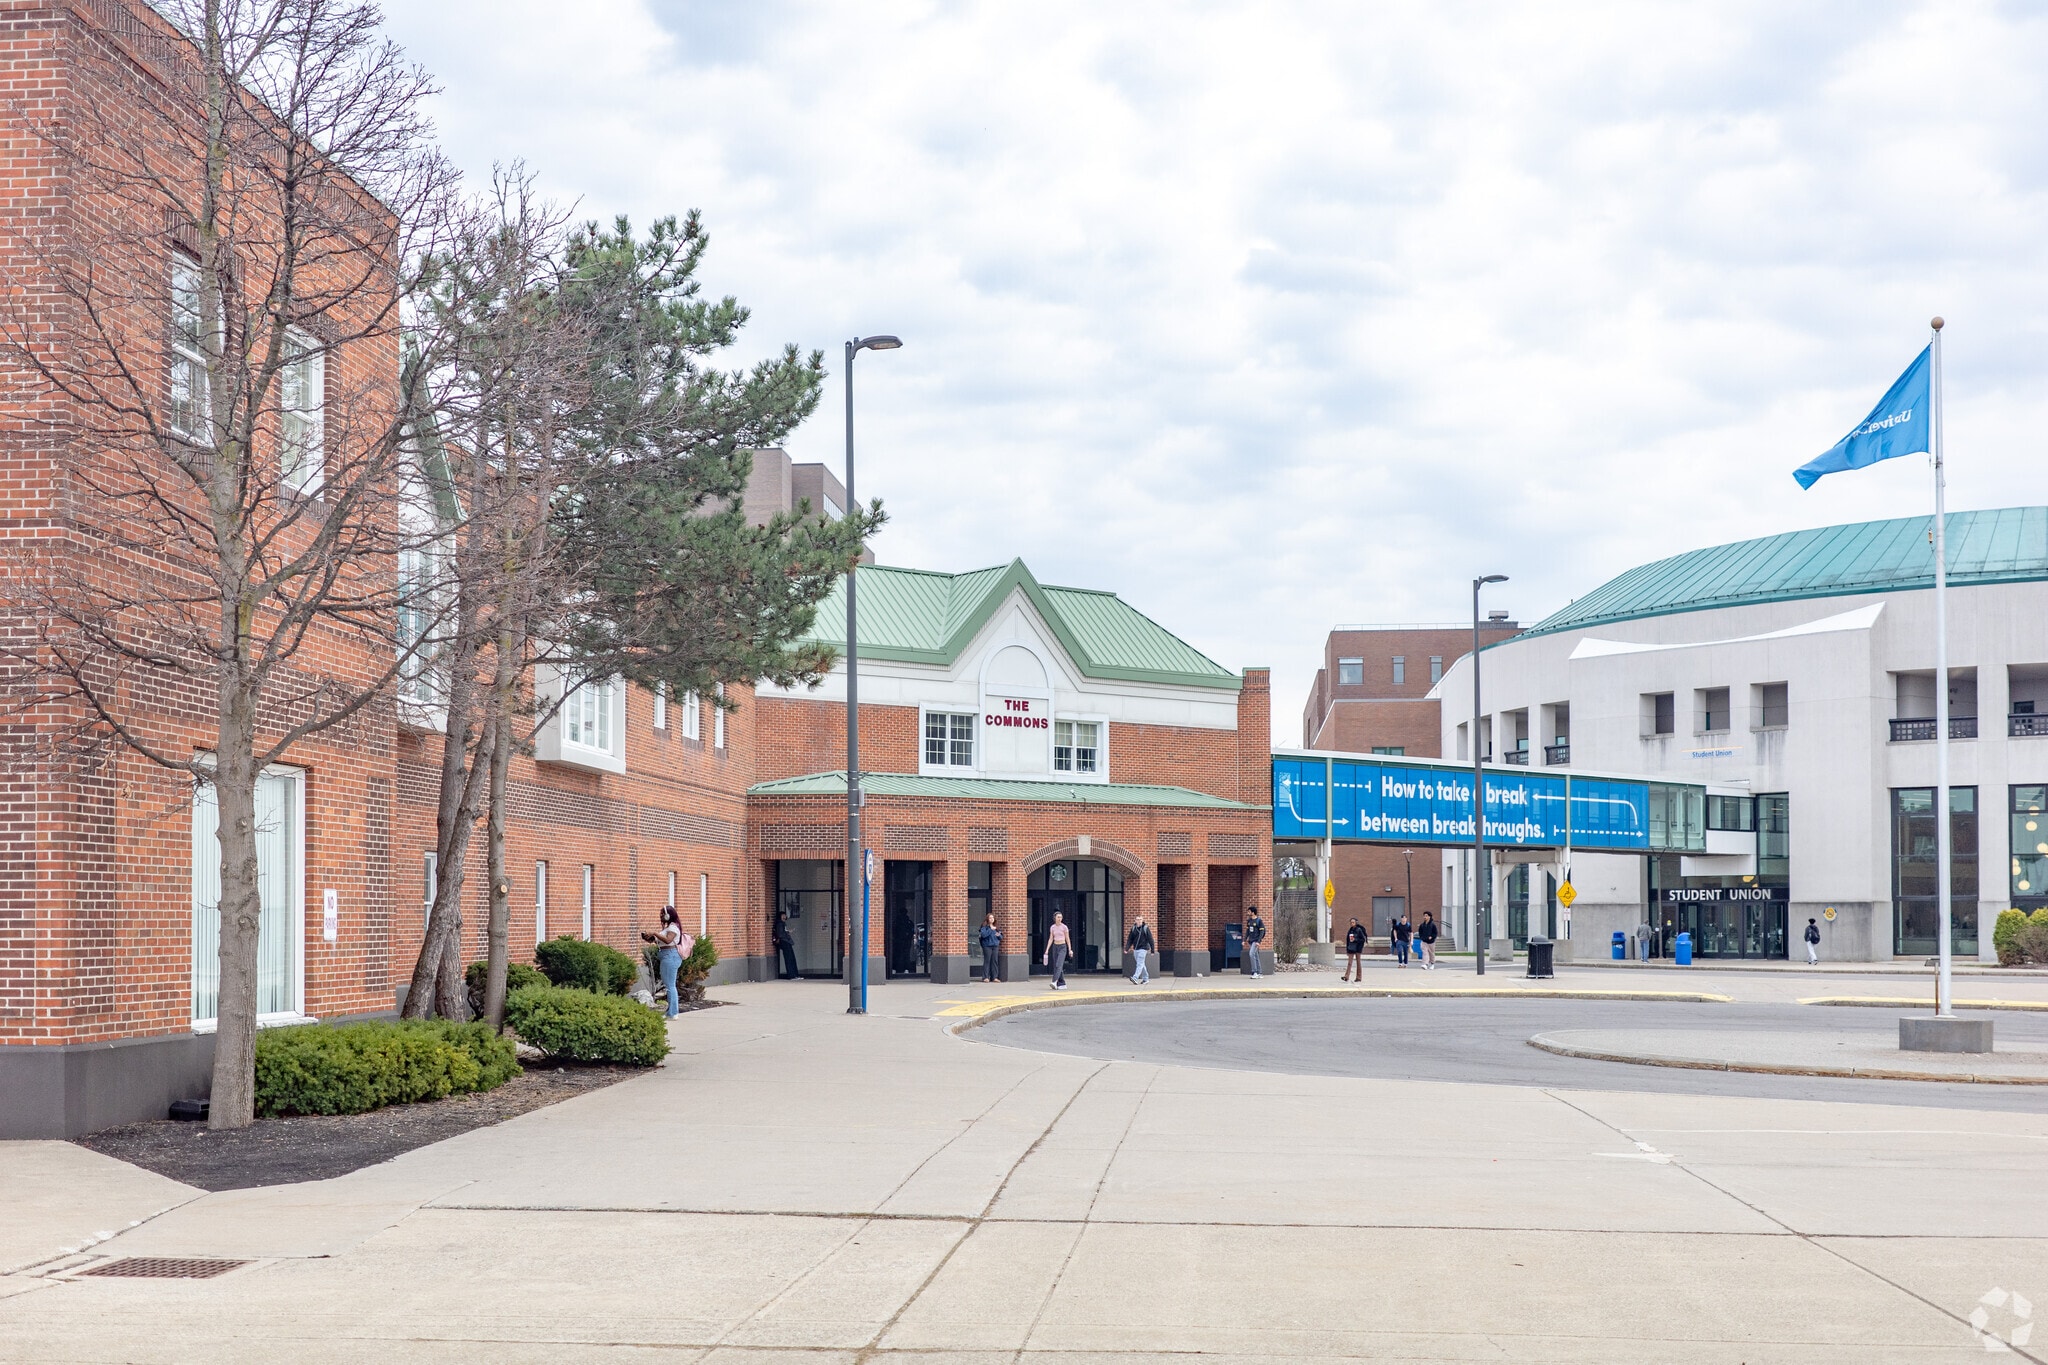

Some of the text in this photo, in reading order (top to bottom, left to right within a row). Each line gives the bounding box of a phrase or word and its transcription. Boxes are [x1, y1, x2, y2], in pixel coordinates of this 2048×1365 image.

[1004, 699, 1029, 711] THE
[985, 714, 1049, 729] COMMONS
[1692, 749, 1732, 758] Student Union
[1381, 776, 1416, 798] How
[1418, 779, 1434, 799] to
[1436, 780, 1470, 801] take
[1486, 782, 1528, 805] break
[1361, 809, 1545, 843] between breakhroughs.
[1669, 888, 1771, 901] STUDENT UNION
